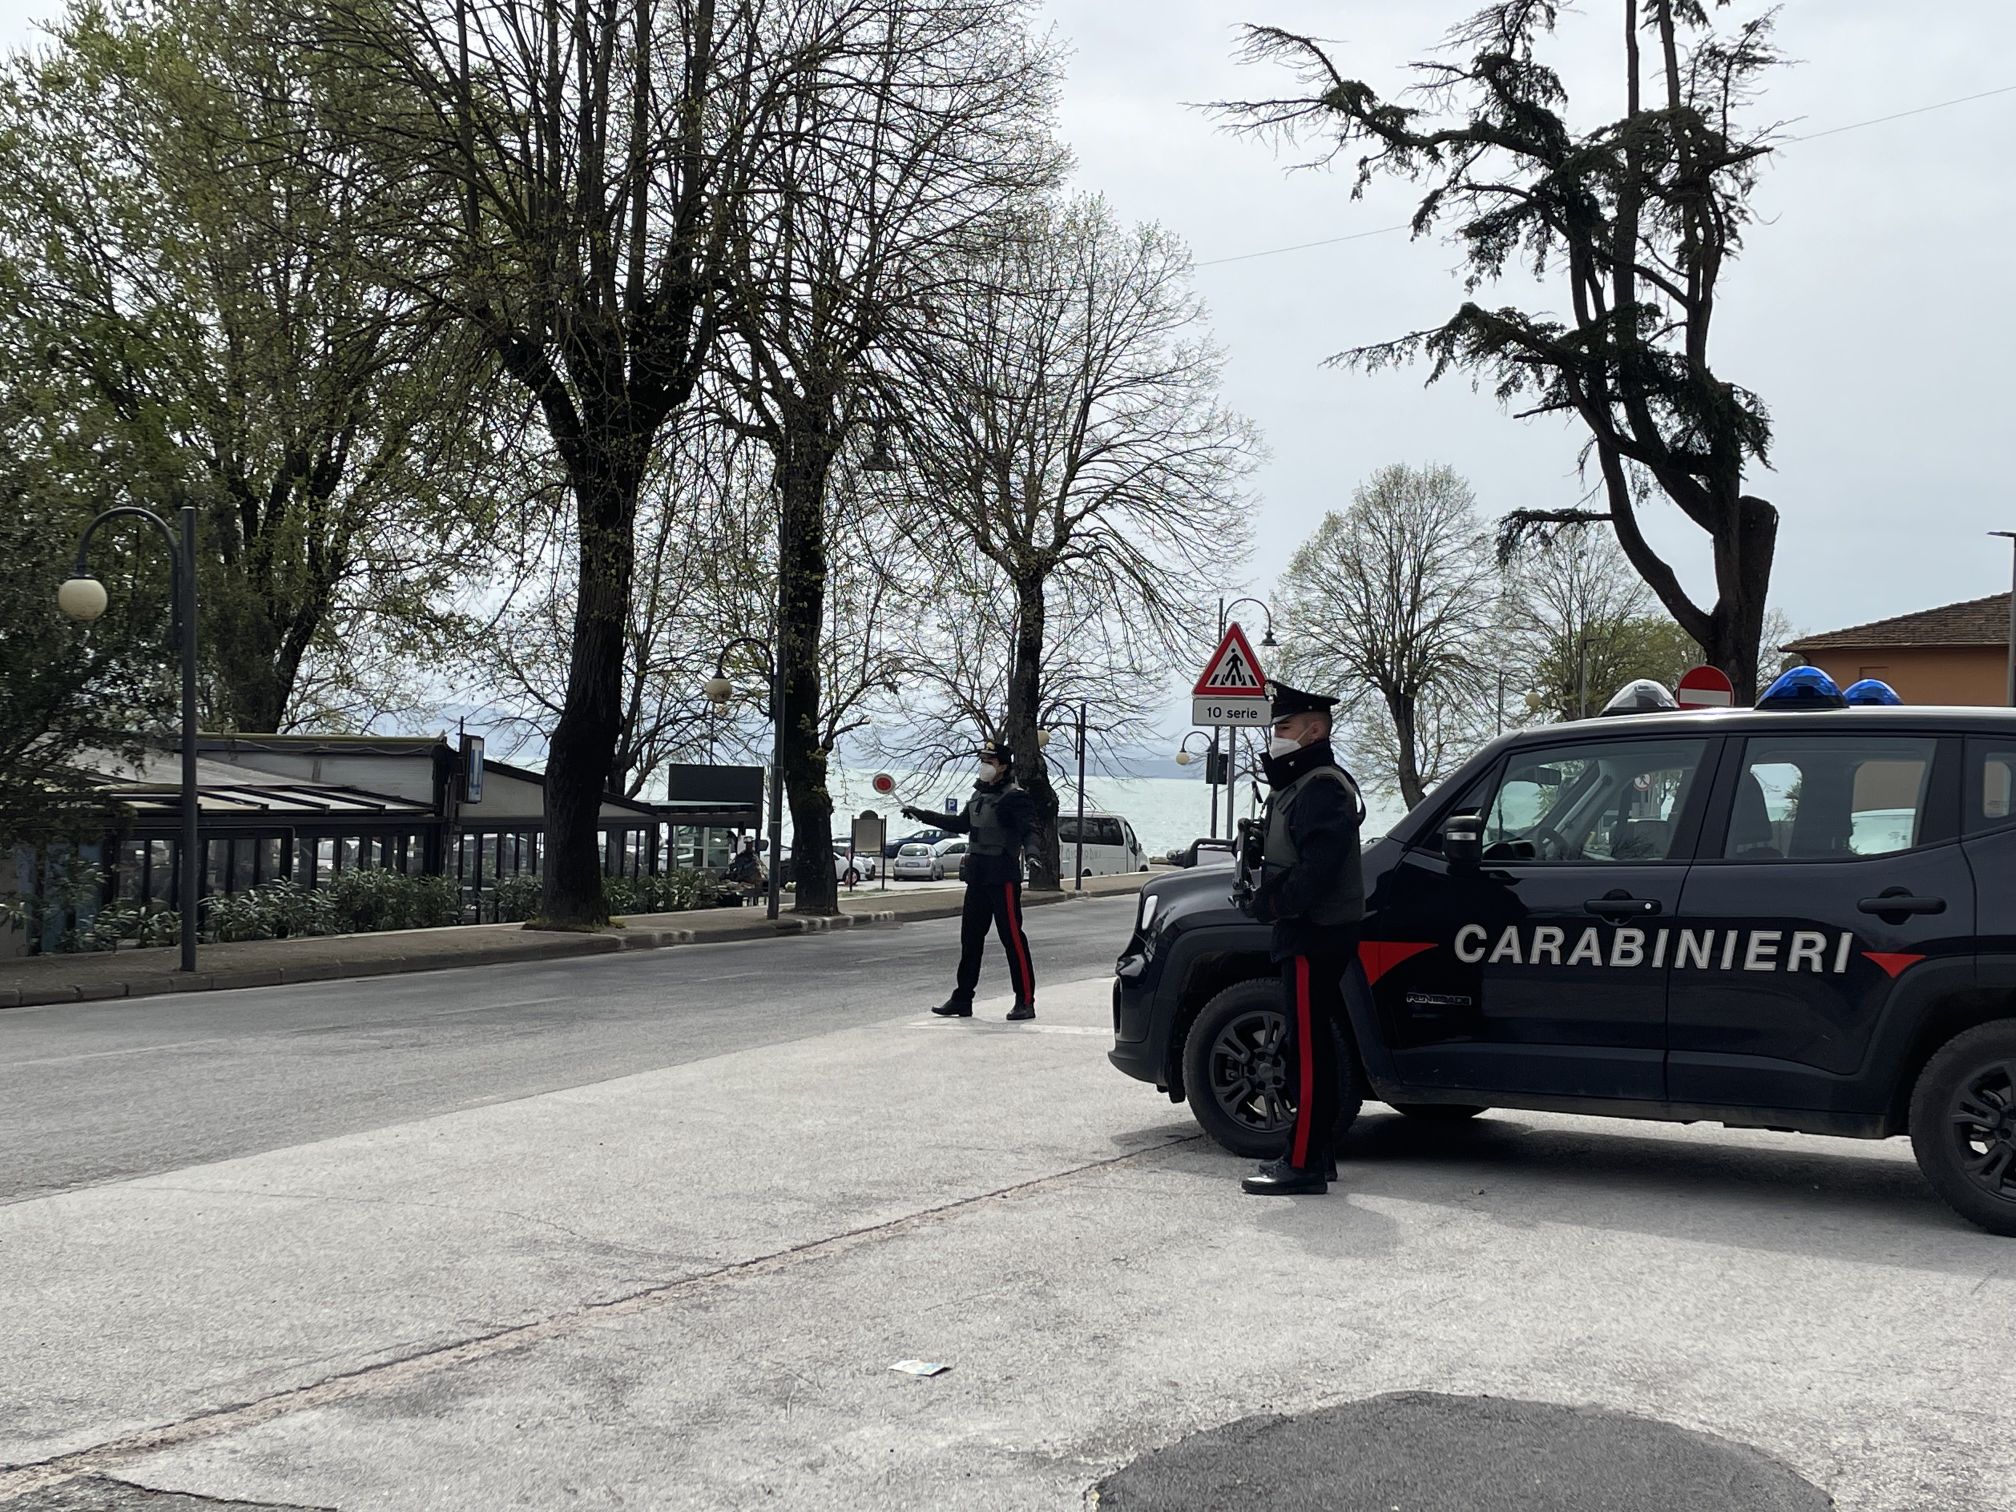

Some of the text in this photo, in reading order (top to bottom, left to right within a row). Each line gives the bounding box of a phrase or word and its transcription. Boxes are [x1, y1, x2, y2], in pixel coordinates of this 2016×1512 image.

[1207, 706, 1258, 719] 10 serie
[947, 799, 956, 810] P
[1454, 923, 1854, 974] CARABINIERI
